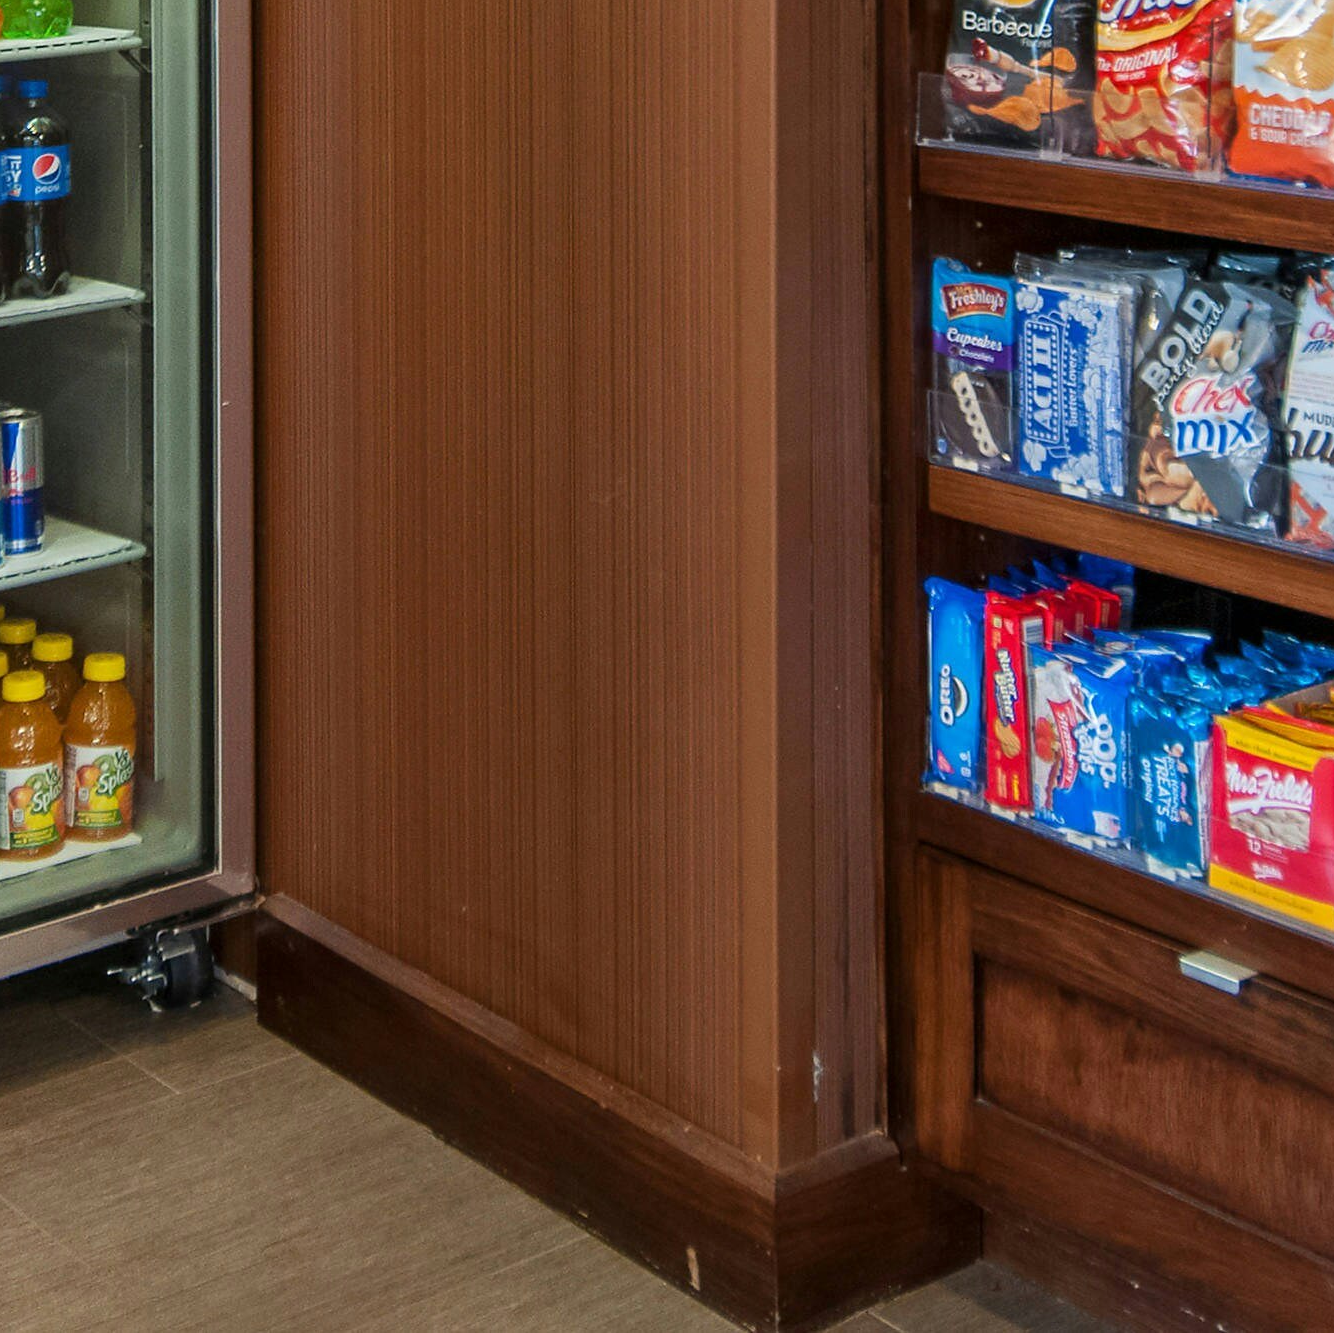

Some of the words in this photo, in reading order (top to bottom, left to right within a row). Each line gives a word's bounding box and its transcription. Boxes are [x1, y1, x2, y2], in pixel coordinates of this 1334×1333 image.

[962, 10, 1053, 38] Barbecue
[1113, 42, 1180, 72] ORIGINAL
[1249, 102, 1332, 131] CHEDDAR
[34, 184, 62, 198] pepsi
[950, 290, 1006, 313] Freshley's
[946, 327, 1004, 352] Cupcakes
[1140, 289, 1215, 392] BOLD
[1190, 302, 1225, 359] blend
[1068, 348, 1079, 388] Lovers
[1033, 370, 1053, 432] ACT
[1068, 389, 1079, 429] Butter
[1174, 374, 1255, 418] Chex
[1175, 412, 1258, 459] mix
[940, 664, 955, 727] OREO
[1248, 838, 1261, 855] 12
